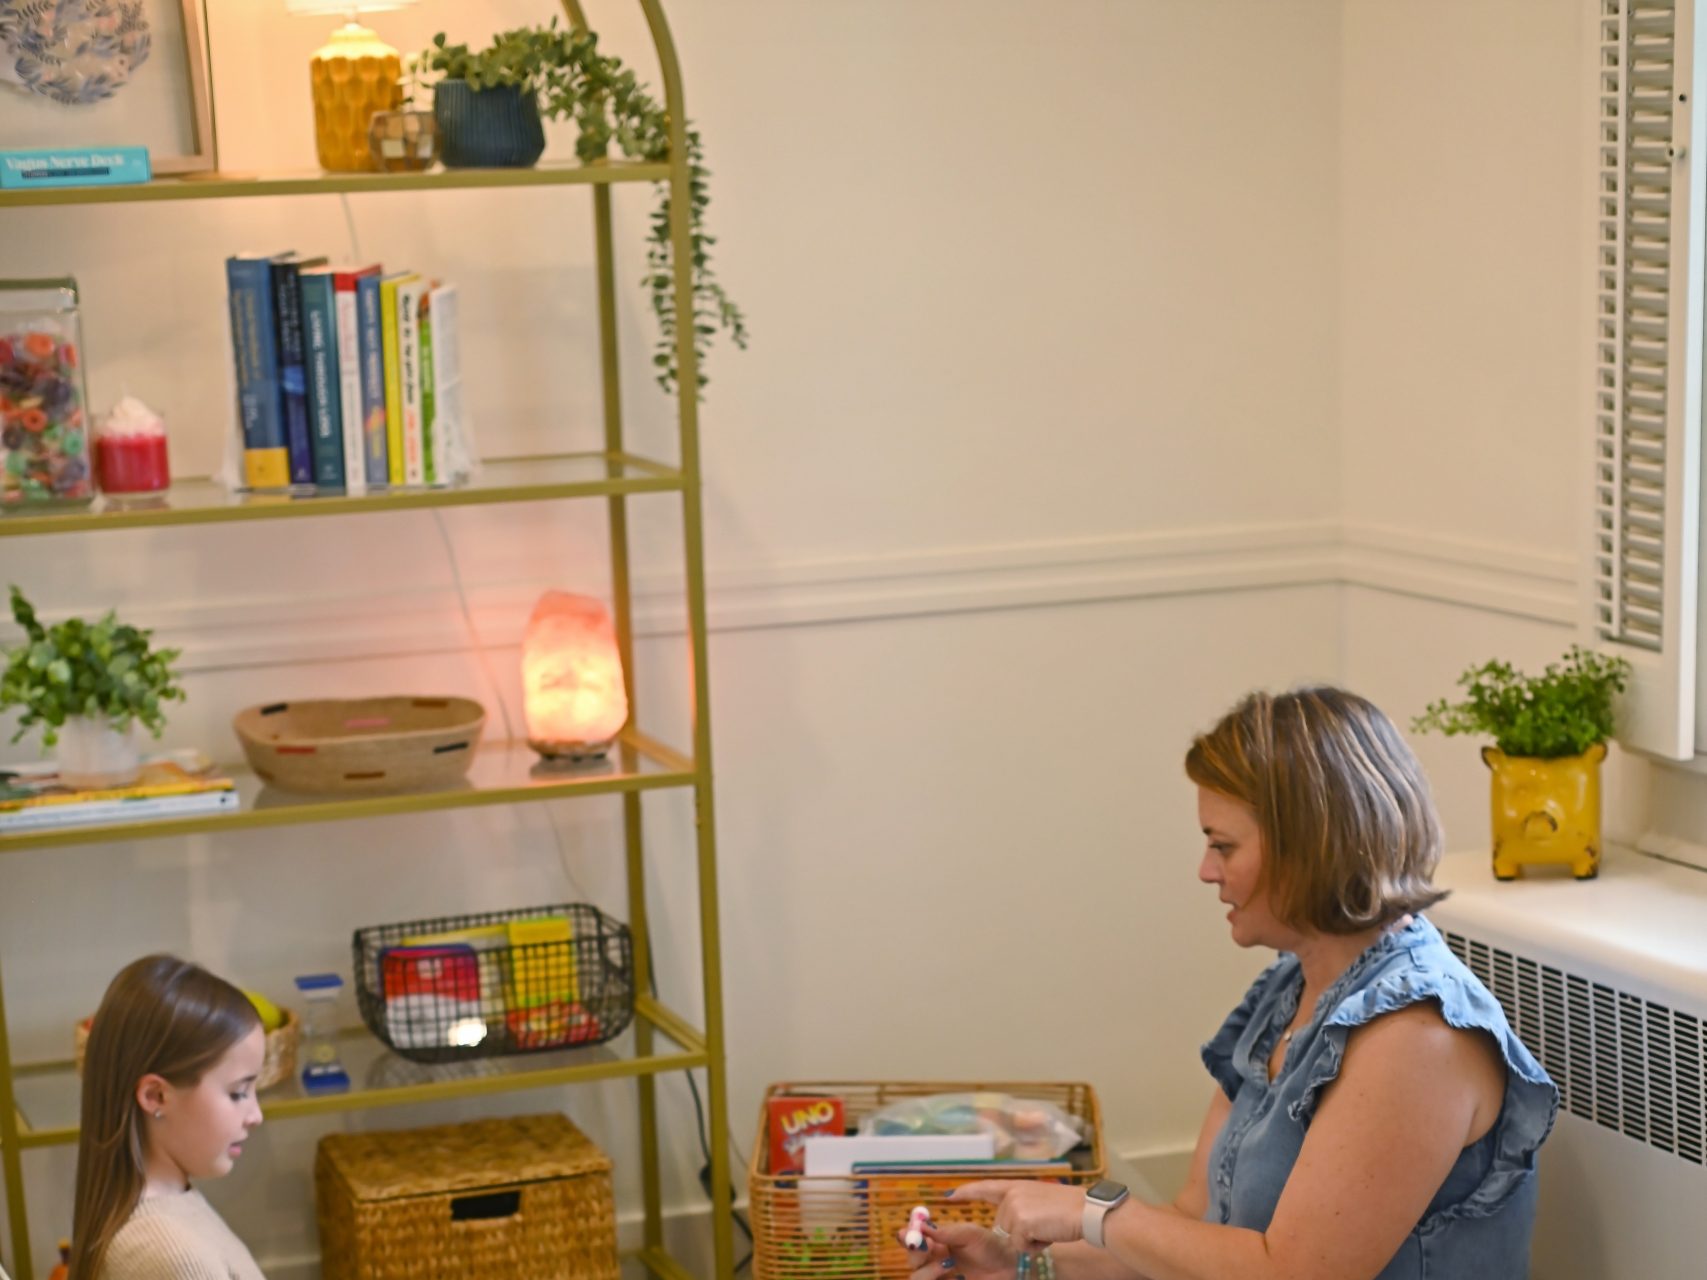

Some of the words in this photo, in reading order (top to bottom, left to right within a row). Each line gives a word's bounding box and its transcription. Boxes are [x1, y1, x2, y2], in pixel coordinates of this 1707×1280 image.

[5, 157, 49, 171] Vagus
[50, 155, 90, 169] Nerve
[91, 153, 124, 167] Deck
[780, 1101, 834, 1133] UNO
